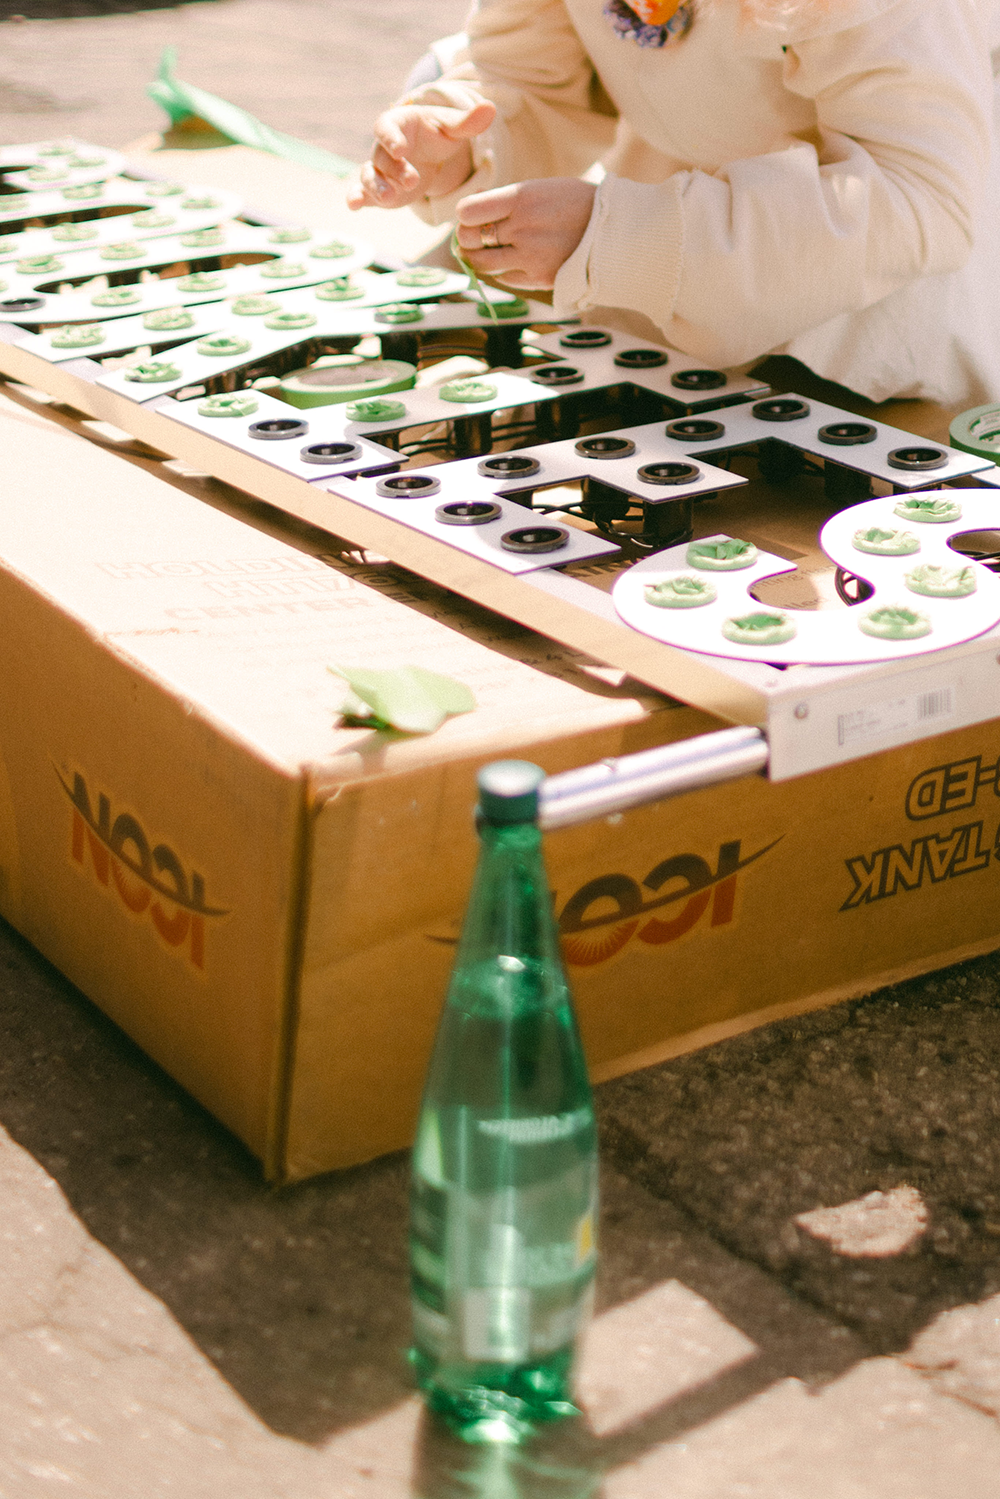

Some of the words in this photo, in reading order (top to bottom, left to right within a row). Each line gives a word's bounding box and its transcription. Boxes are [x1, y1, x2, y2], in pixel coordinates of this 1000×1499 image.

[67, 768, 210, 970] ICON
[515, 838, 744, 967] ICO
[838, 820, 991, 912] TANK
